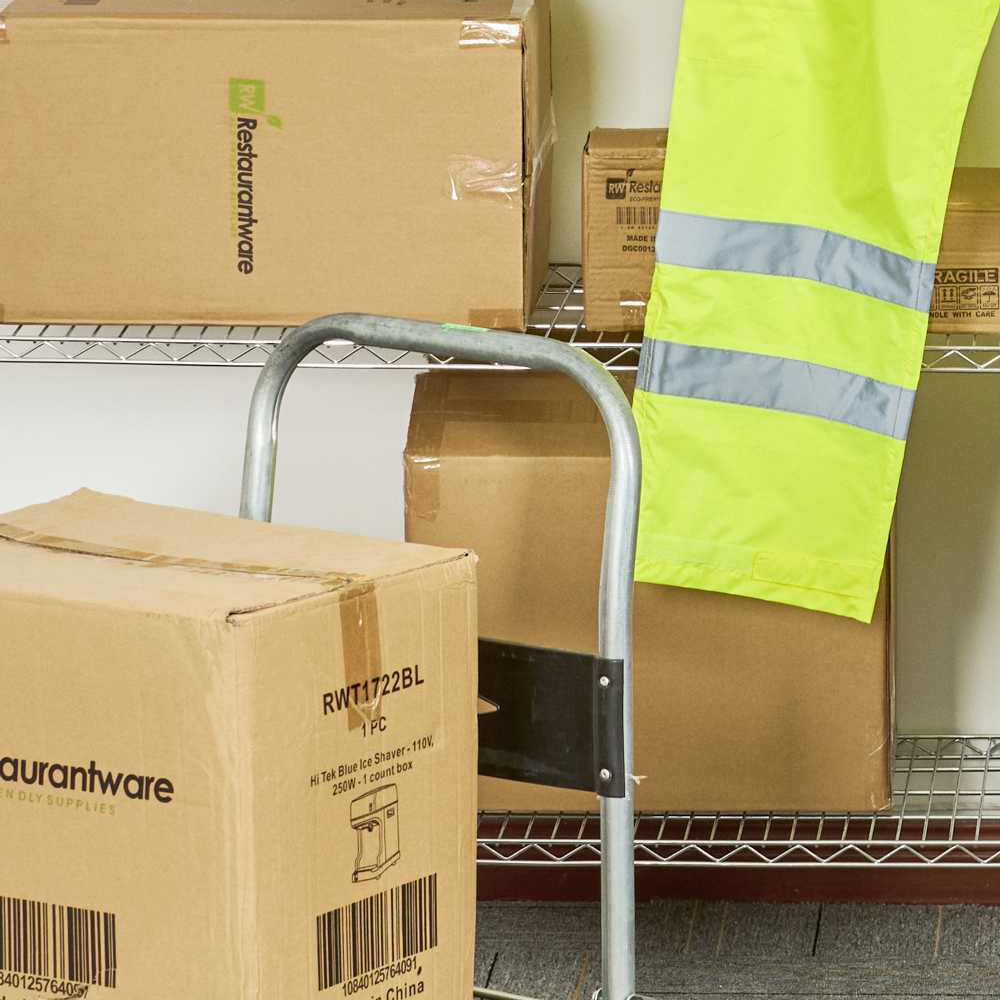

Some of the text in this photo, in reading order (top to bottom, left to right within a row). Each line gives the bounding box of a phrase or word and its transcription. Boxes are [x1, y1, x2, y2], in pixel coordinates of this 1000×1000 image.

[237, 117, 258, 275] Restaurantware
[608, 183, 625, 194] RW
[322, 664, 425, 716] RWT1722BL
[361, 716, 387, 738] 1 PC
[0, 756, 174, 803] aurantware
[310, 775, 319, 787] Hi
[321, 767, 336, 783] Tek
[338, 763, 358, 777] Blue
[360, 758, 372, 770] Ice
[374, 746, 405, 764] Shaver
[412, 735, 434, 752] 110V,
[333, 777, 356, 796] 250W
[363, 774, 367, 784] 1
[369, 765, 395, 783] count
[397, 761, 413, 774] box
[47, 794, 117, 817] SUPPLIES
[342, 956, 417, 997] 10840125764091
[386, 981, 425, 1000] China
